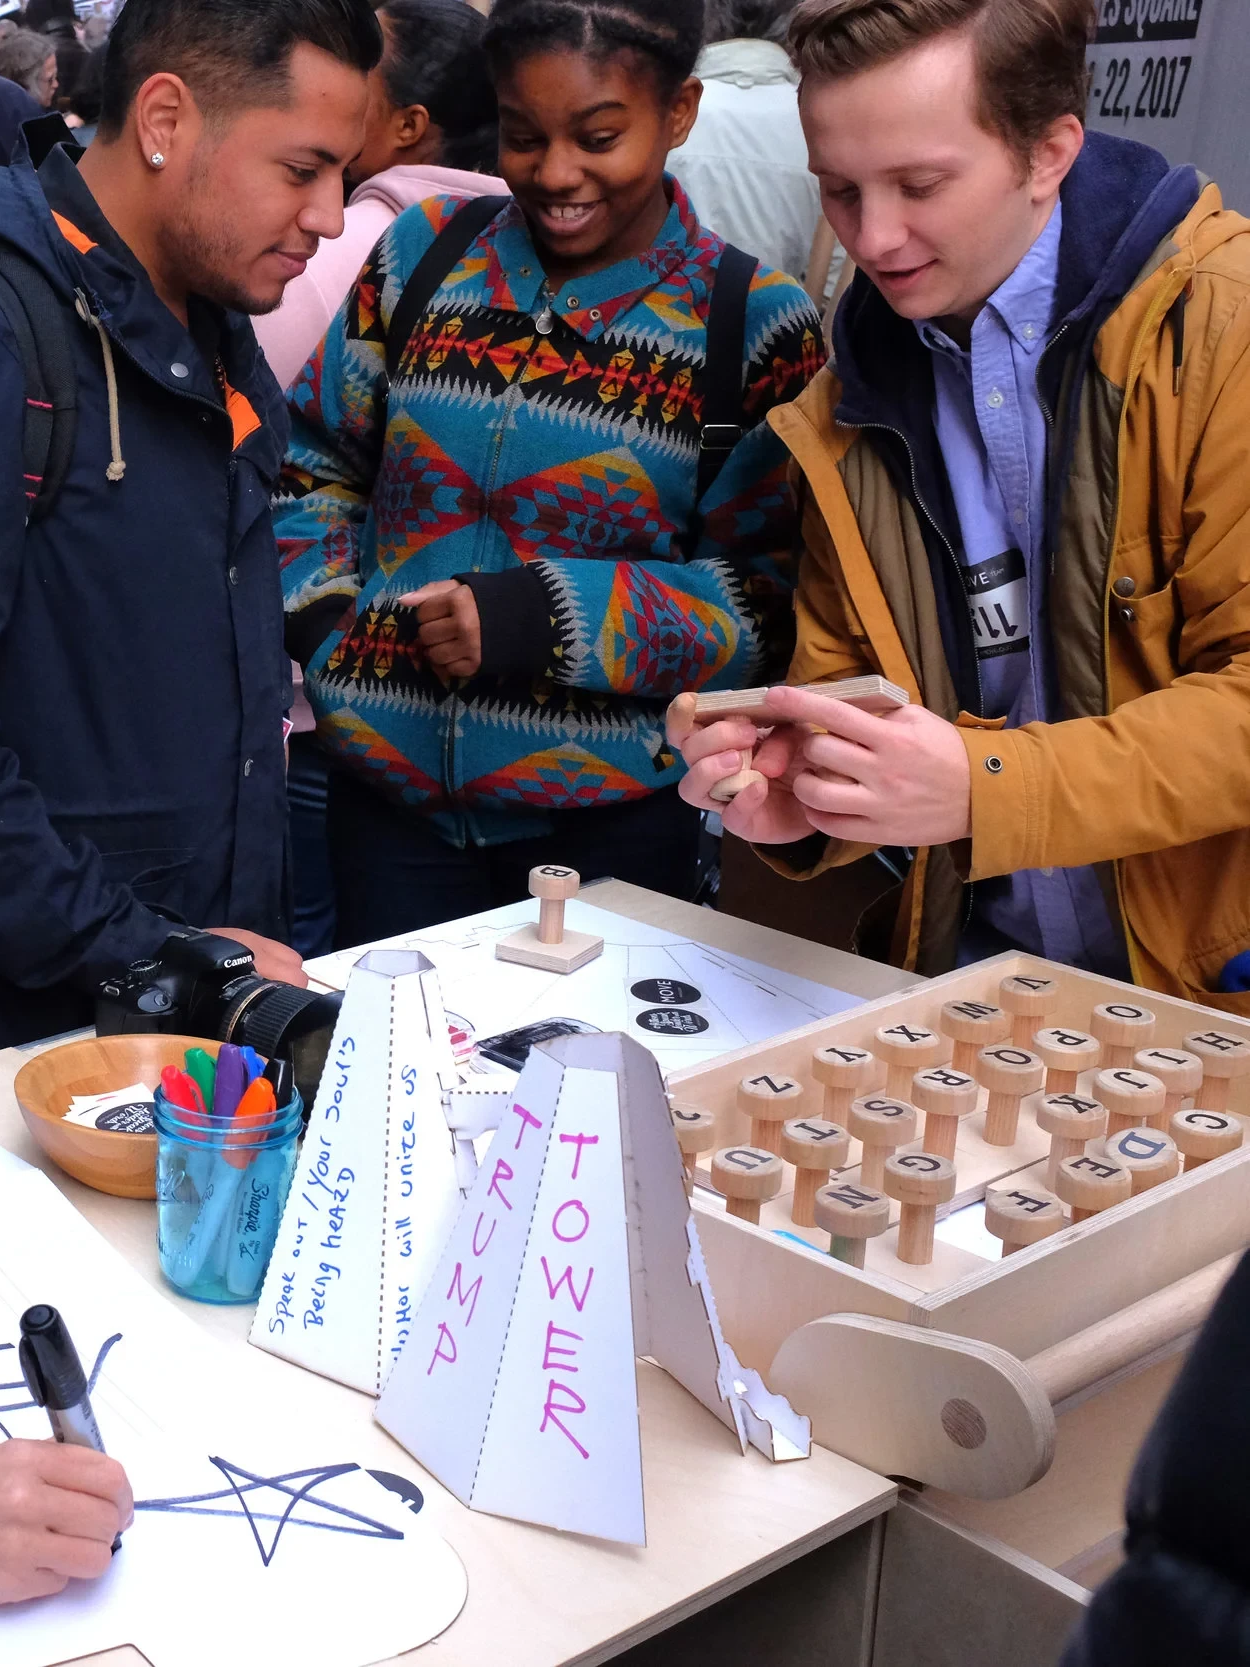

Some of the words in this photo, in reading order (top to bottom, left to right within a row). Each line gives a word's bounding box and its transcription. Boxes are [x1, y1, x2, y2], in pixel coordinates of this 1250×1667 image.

[1134, 56, 1192, 118] 2017
[540, 866, 573, 877] B
[223, 954, 253, 968] Canon
[656, 980, 676, 1003] MOVE
[1012, 976, 1052, 990] V
[1105, 1005, 1143, 1019] O
[884, 1024, 932, 1043] X
[1050, 1030, 1088, 1046] P
[1191, 1032, 1244, 1051] H
[825, 1047, 867, 1062] Y
[984, 1049, 1032, 1065] Q
[1148, 1051, 1189, 1065] I
[401, 1064, 417, 1096] us
[749, 1075, 794, 1093] Z
[921, 1069, 972, 1086] R
[1113, 1071, 1149, 1089] J
[863, 1100, 904, 1117] S
[1046, 1094, 1099, 1114] K
[1184, 1113, 1229, 1130] C
[794, 1122, 839, 1141] T
[396, 1111, 416, 1198] unite
[1118, 1131, 1167, 1160] D
[724, 1150, 773, 1170] U
[897, 1155, 942, 1172] G
[1069, 1157, 1122, 1179] E
[825, 1184, 880, 1209] N
[1006, 1191, 1052, 1213] F
[245, 1178, 270, 1236] Sharpie
[395, 1216, 413, 1257] will
[426, 1102, 544, 1376] TRUMP
[303, 1262, 342, 1329] Being
[540, 1132, 600, 1460] TOWER
